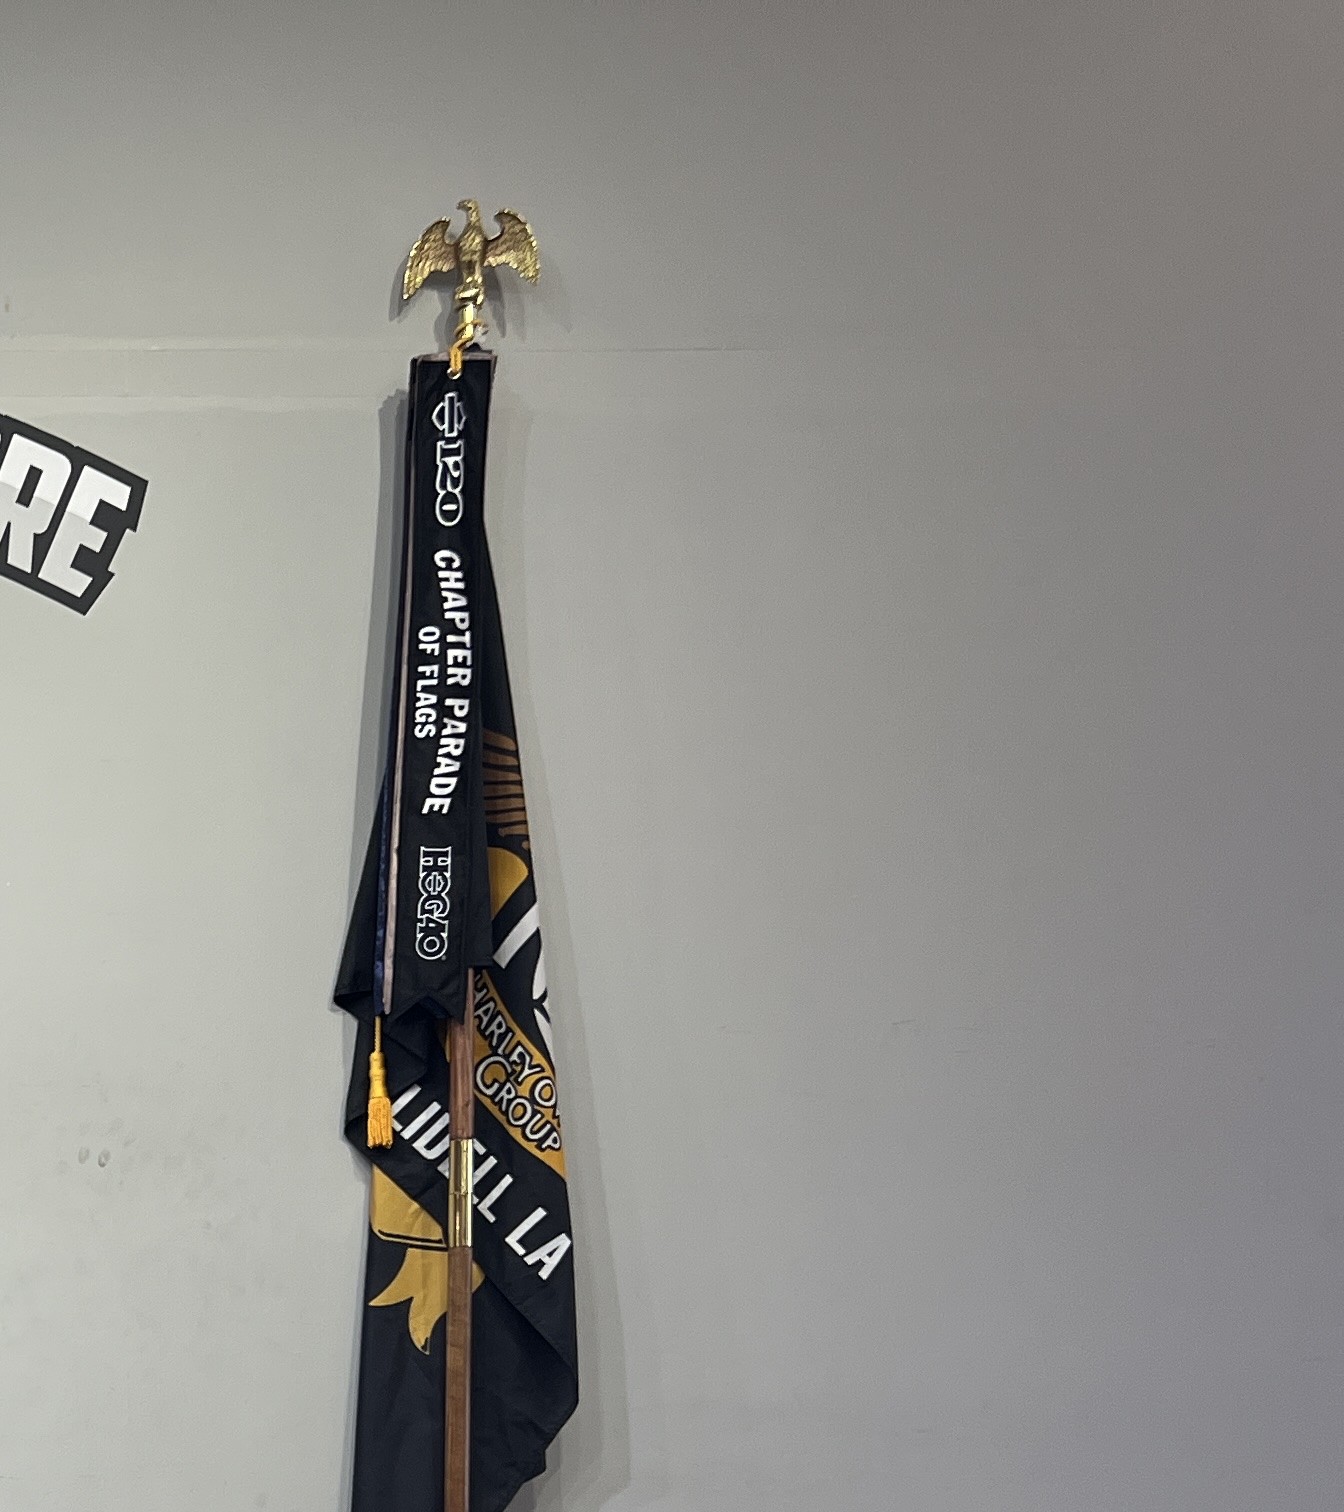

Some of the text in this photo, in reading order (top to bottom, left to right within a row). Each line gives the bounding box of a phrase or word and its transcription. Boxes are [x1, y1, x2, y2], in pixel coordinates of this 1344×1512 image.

[413, 624, 441, 740] OF FLAGS
[420, 548, 474, 816] CHAPTER PARADE
[475, 1055, 562, 1151] GROUP
[504, 1206, 572, 1281] LA
